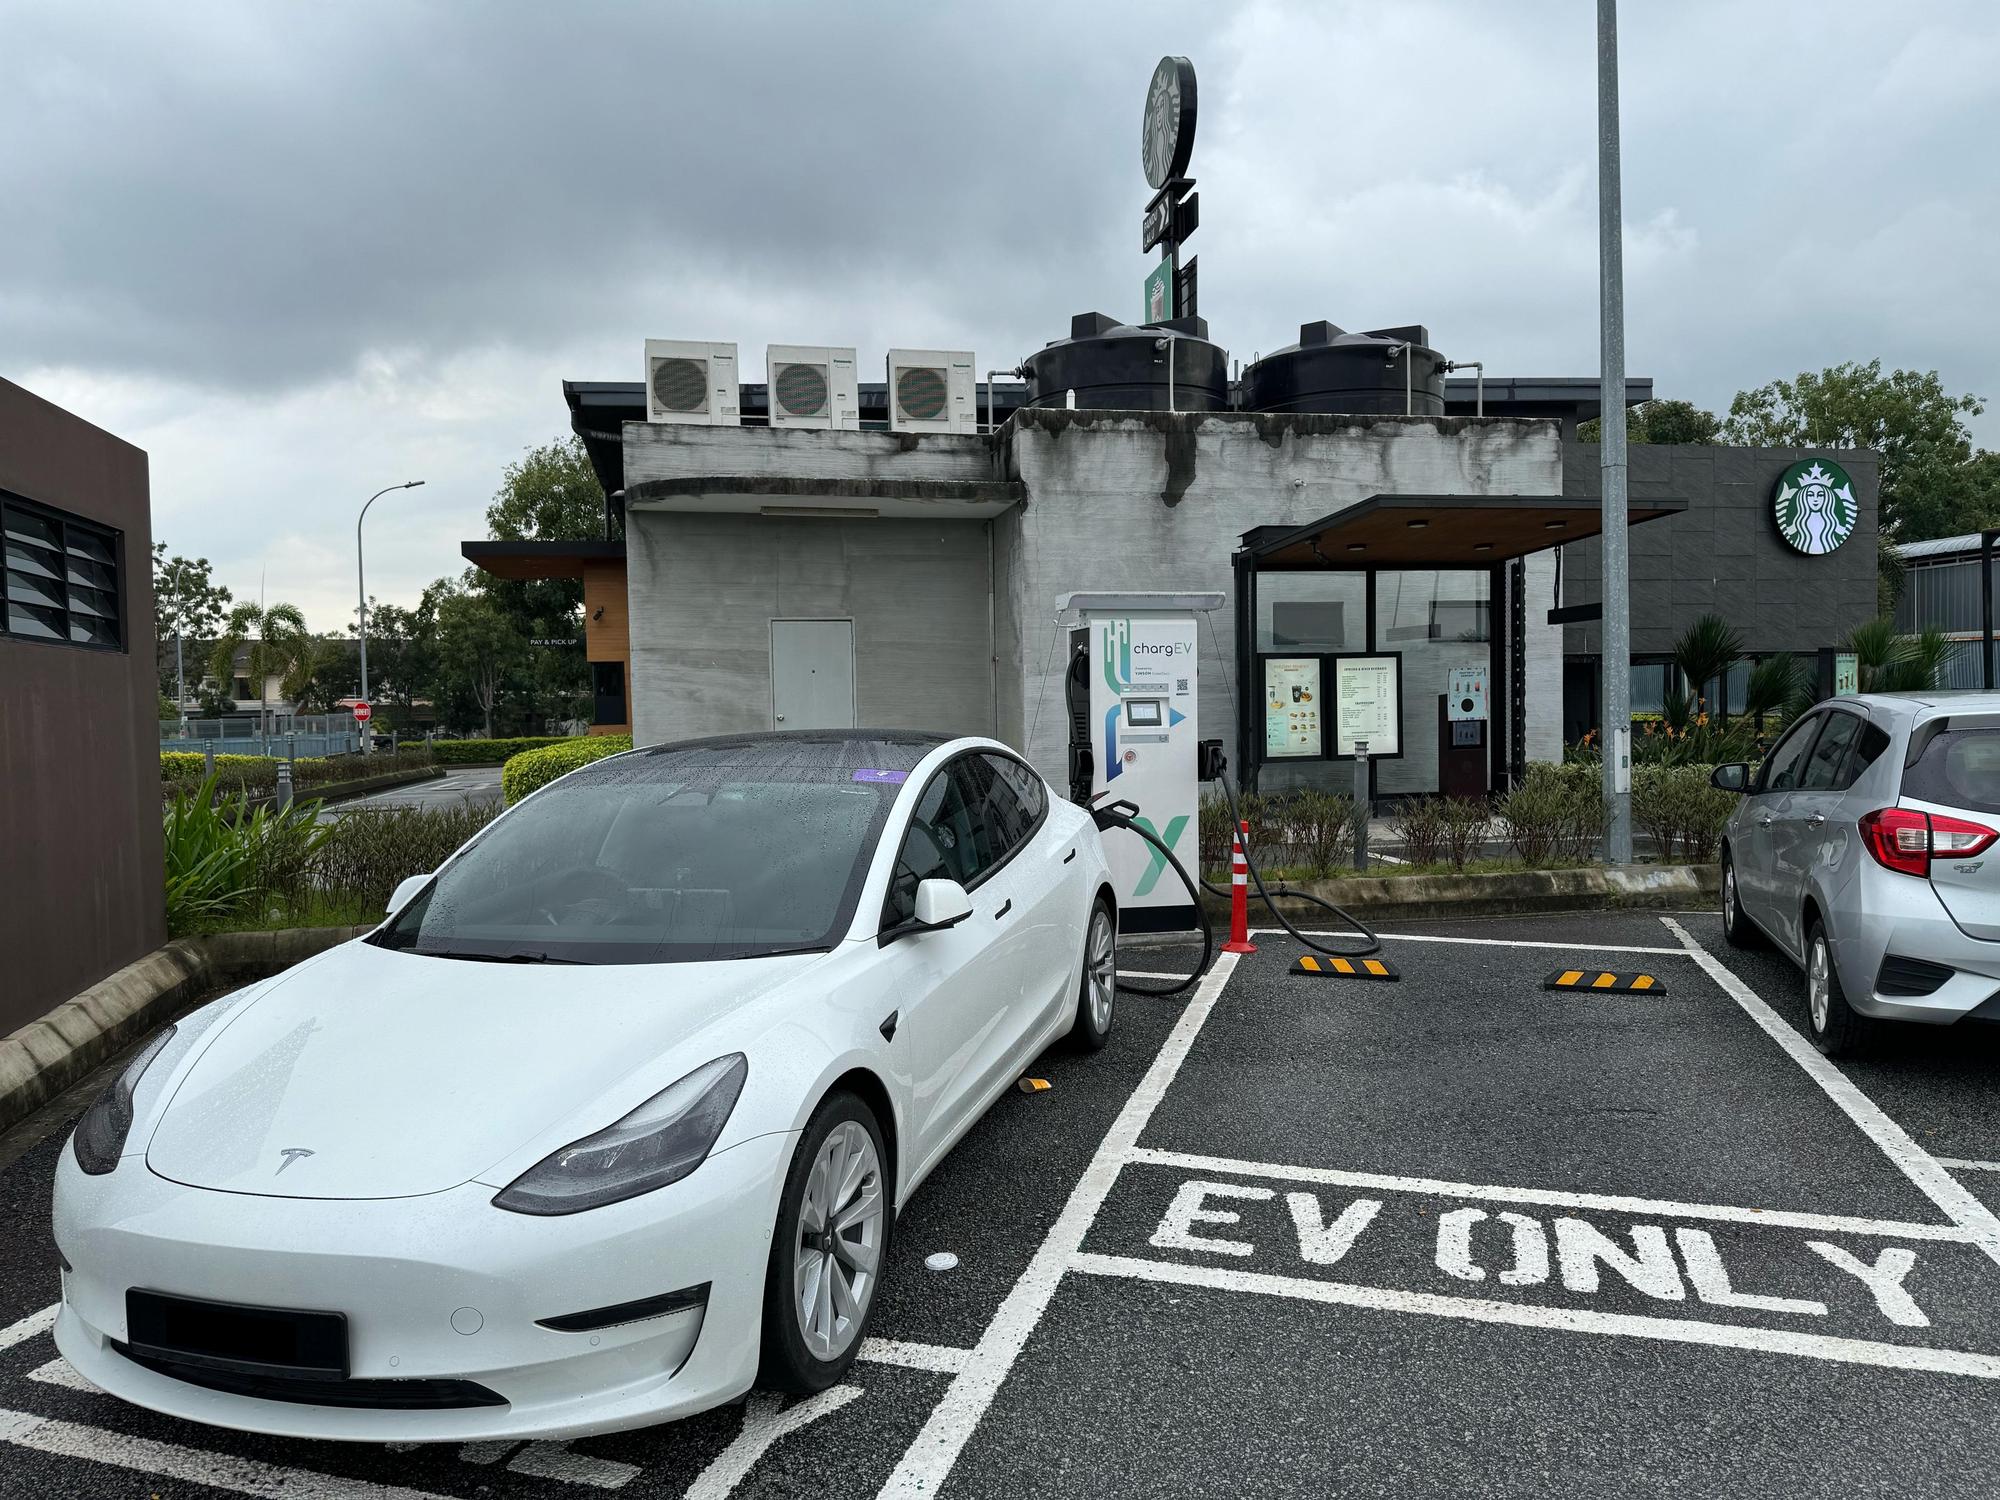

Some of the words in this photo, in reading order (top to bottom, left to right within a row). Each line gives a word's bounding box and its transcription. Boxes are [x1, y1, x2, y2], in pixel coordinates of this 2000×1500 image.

[1134, 642, 1192, 657] chargEV
[1149, 1180, 1383, 1264] EV
[1435, 1207, 1931, 1327] ONLY
